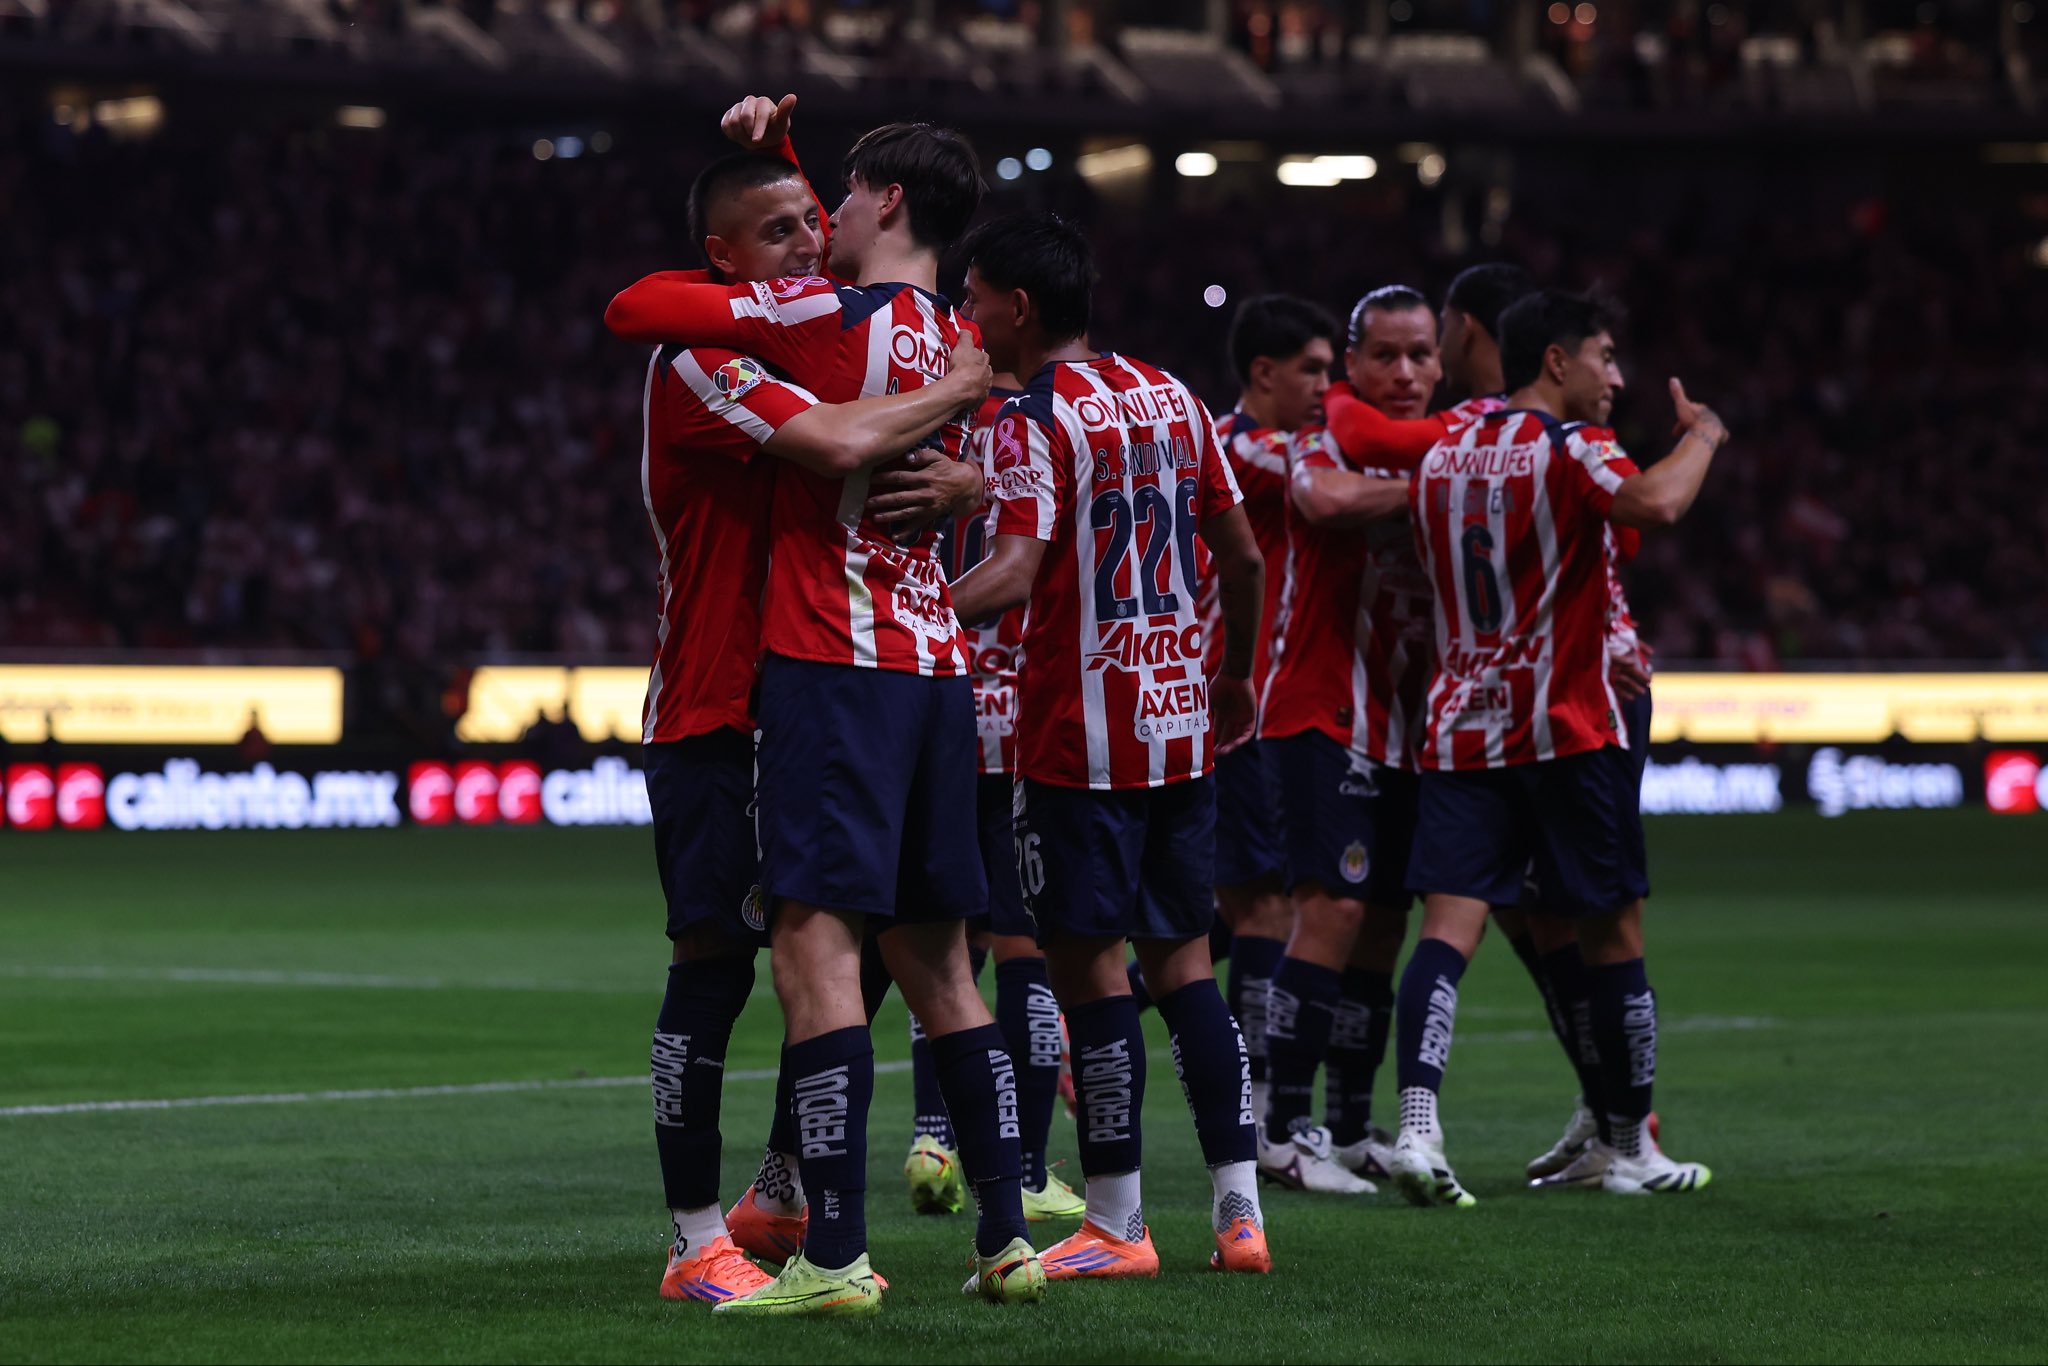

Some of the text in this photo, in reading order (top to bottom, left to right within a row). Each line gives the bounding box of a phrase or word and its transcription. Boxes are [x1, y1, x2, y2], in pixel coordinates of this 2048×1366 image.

[737, 378, 759, 396] BBVA
[1001, 470, 1041, 490] GNP
[1120, 436, 1198, 477] SNDOVAL
[1461, 523, 1503, 635] 6
[1085, 622, 1203, 672] AKRO
[1139, 681, 1207, 720] AXEN
[1139, 717, 1208, 737] CAPITAL
[106, 757, 400, 831] caliente.mx
[1266, 985, 1301, 1040] PERD
[651, 1031, 692, 1128] PERDURA
[988, 1048, 1021, 1139] PERDU
[1081, 1038, 1133, 1143] PERDURA
